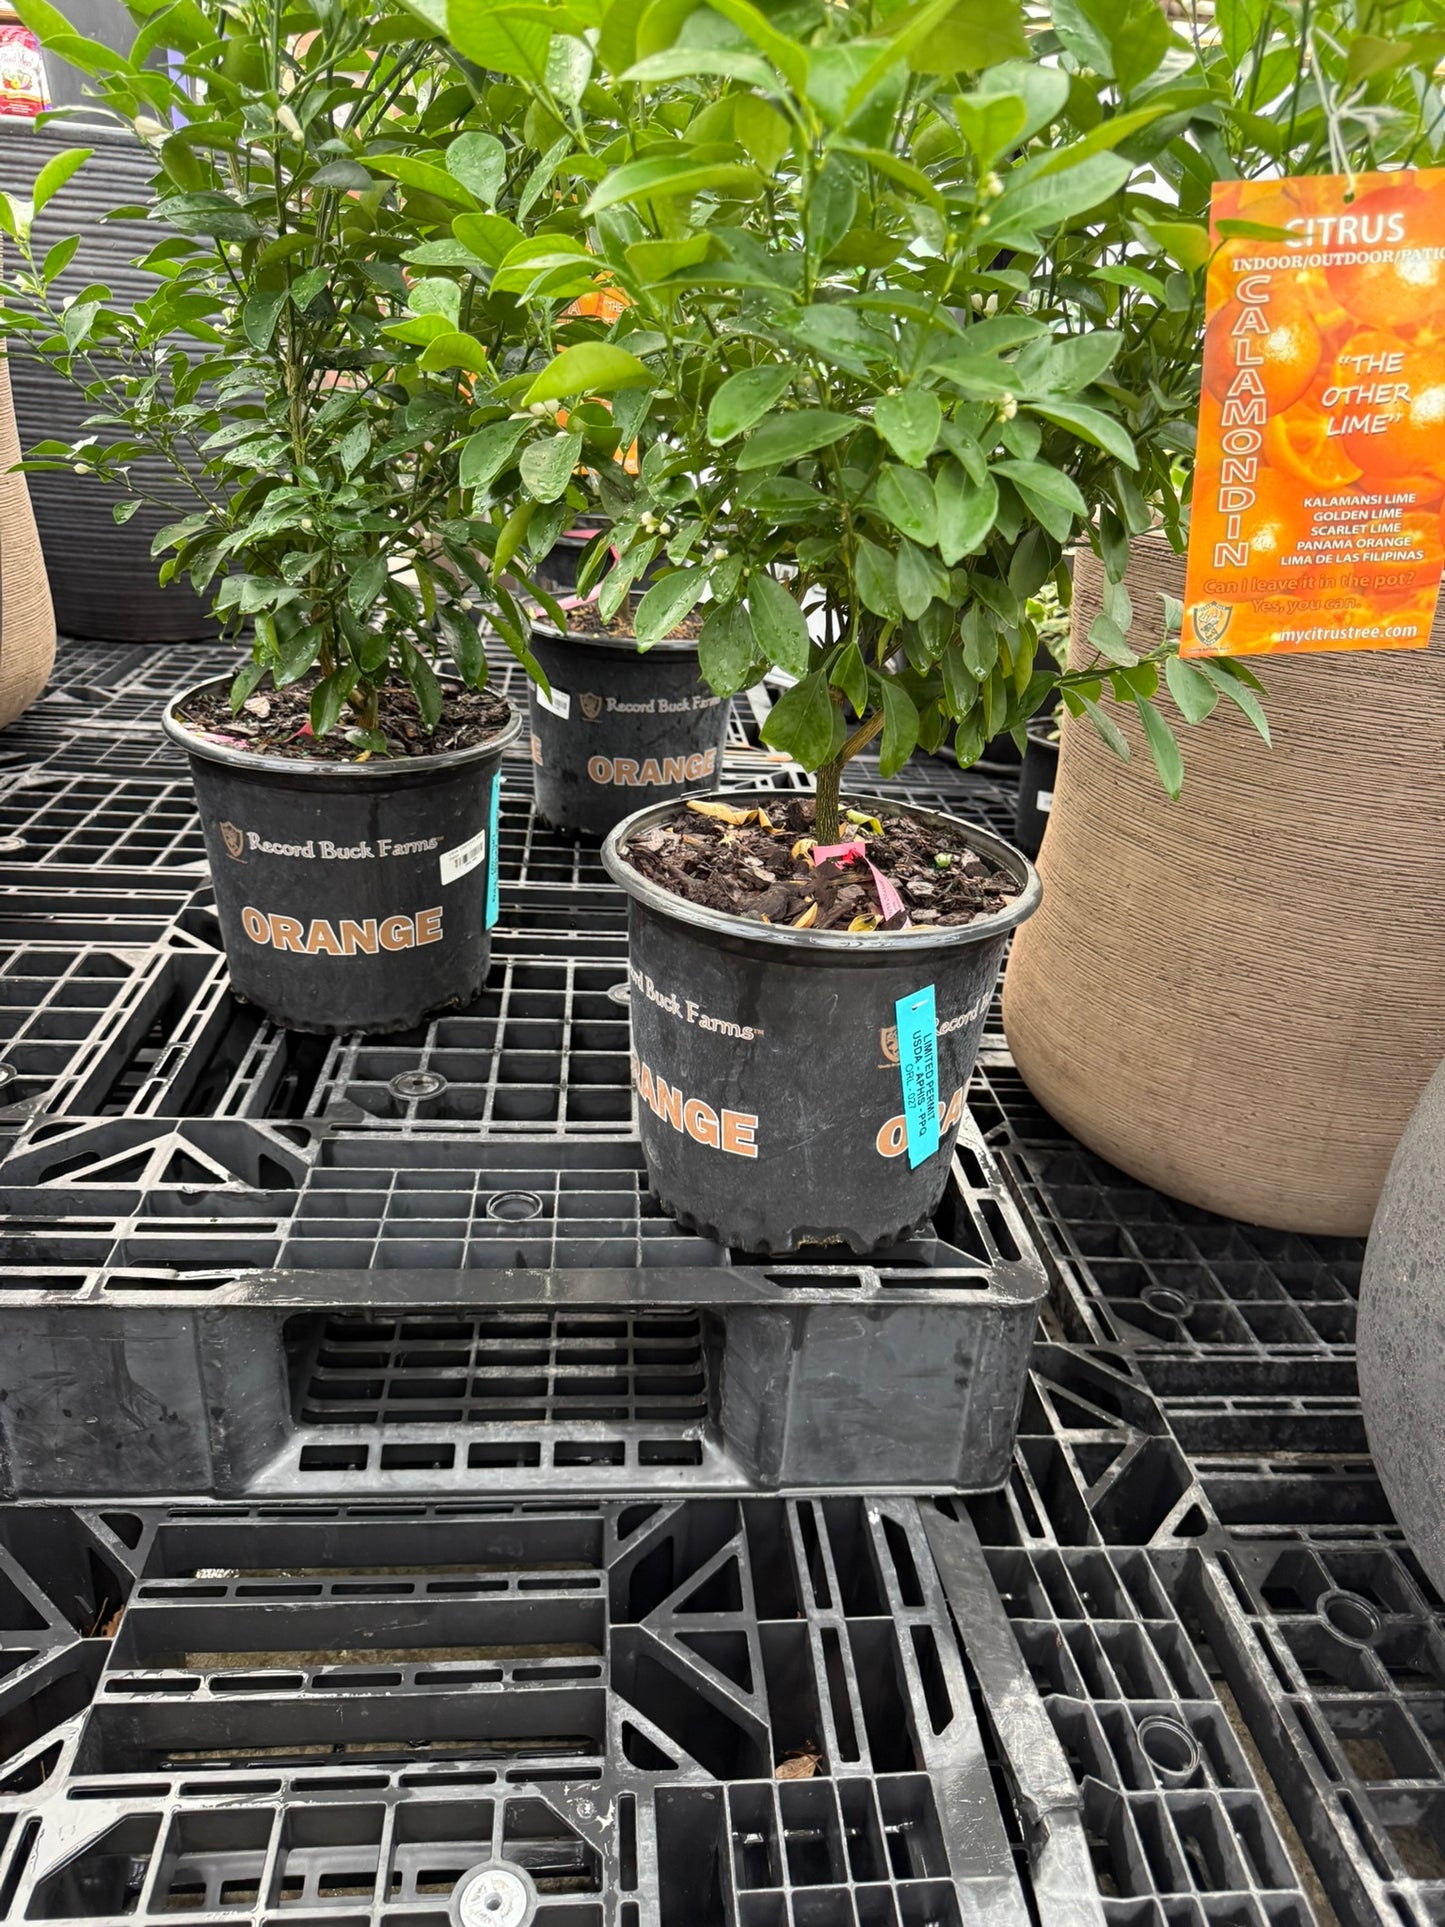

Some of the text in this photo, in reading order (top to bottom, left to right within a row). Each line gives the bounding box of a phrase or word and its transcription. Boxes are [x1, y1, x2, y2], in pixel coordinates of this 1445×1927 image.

[1284, 213, 1406, 248] CITRUS
[1322, 383, 1412, 407] OTHER
[1213, 274, 1272, 567] CALAMONDIN
[1304, 493, 1417, 508] KALAMANSI LIME
[1313, 508, 1403, 522] GOLDEN LIME
[1311, 522, 1402, 537] SCARLET LIME
[1296, 536, 1412, 551] PANAMA ORANGE
[1280, 550, 1424, 566] LIMA DE LAS FILIPINAS
[1203, 571, 1415, 594] Can I leave it in the pot?
[1252, 598, 1362, 617] Yes, you can.
[1279, 624, 1418, 645] mycitrustree.com
[606, 698, 655, 713] Record
[657, 698, 691, 713] Buck
[588, 747, 717, 786] ORANGE
[247, 831, 316, 859] Record
[318, 840, 375, 860] Buck
[241, 905, 444, 955] ORANGE
[645, 974, 684, 1020] Buck
[911, 1029, 923, 1065] USDA
[905, 1063, 915, 1086] ORL
[922, 1032, 936, 1121] LIMITED PERMIT
[908, 1092, 917, 1109] 027
[915, 1072, 925, 1106] APHIS
[917, 1111, 927, 1137] PPQ
